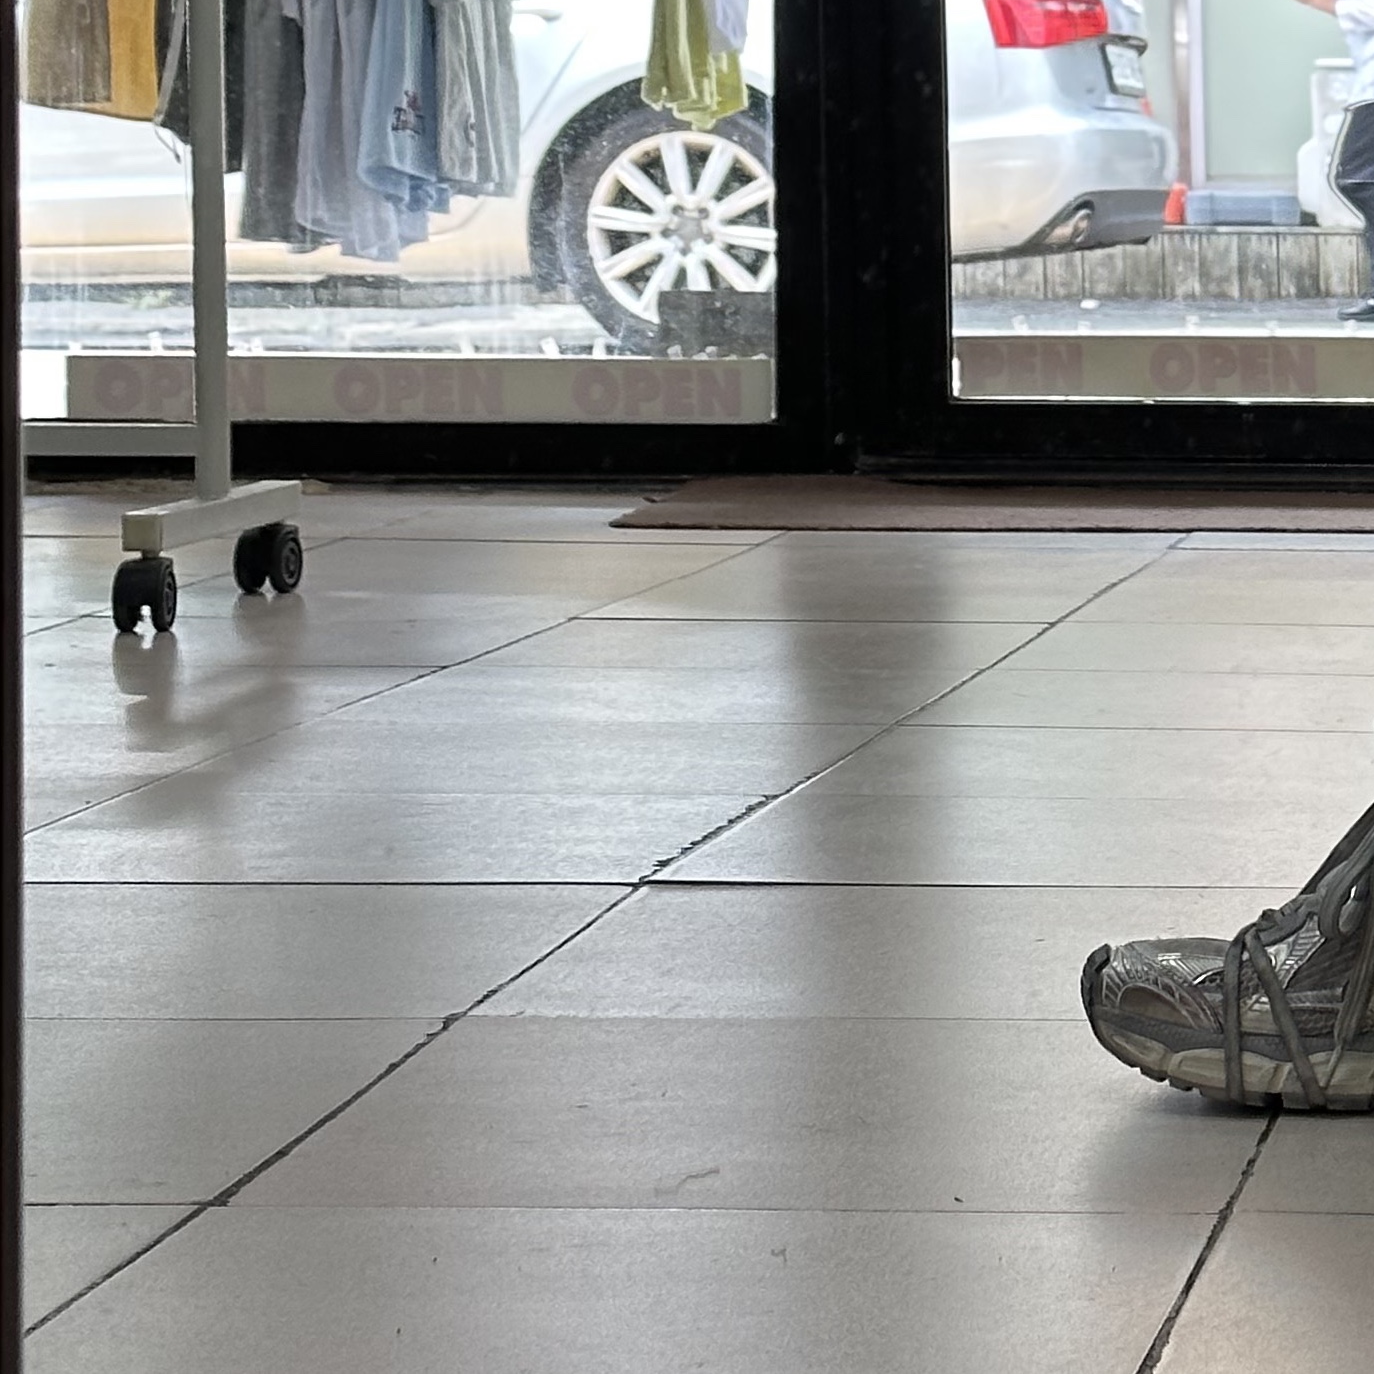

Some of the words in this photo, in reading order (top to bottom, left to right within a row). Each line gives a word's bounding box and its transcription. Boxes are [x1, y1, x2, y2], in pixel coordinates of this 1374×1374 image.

[94, 364, 266, 412] OPN
[332, 364, 505, 416] OPEN
[571, 367, 743, 417] OPEN
[957, 343, 1083, 392] PEN
[1149, 344, 1316, 392] OPEN
